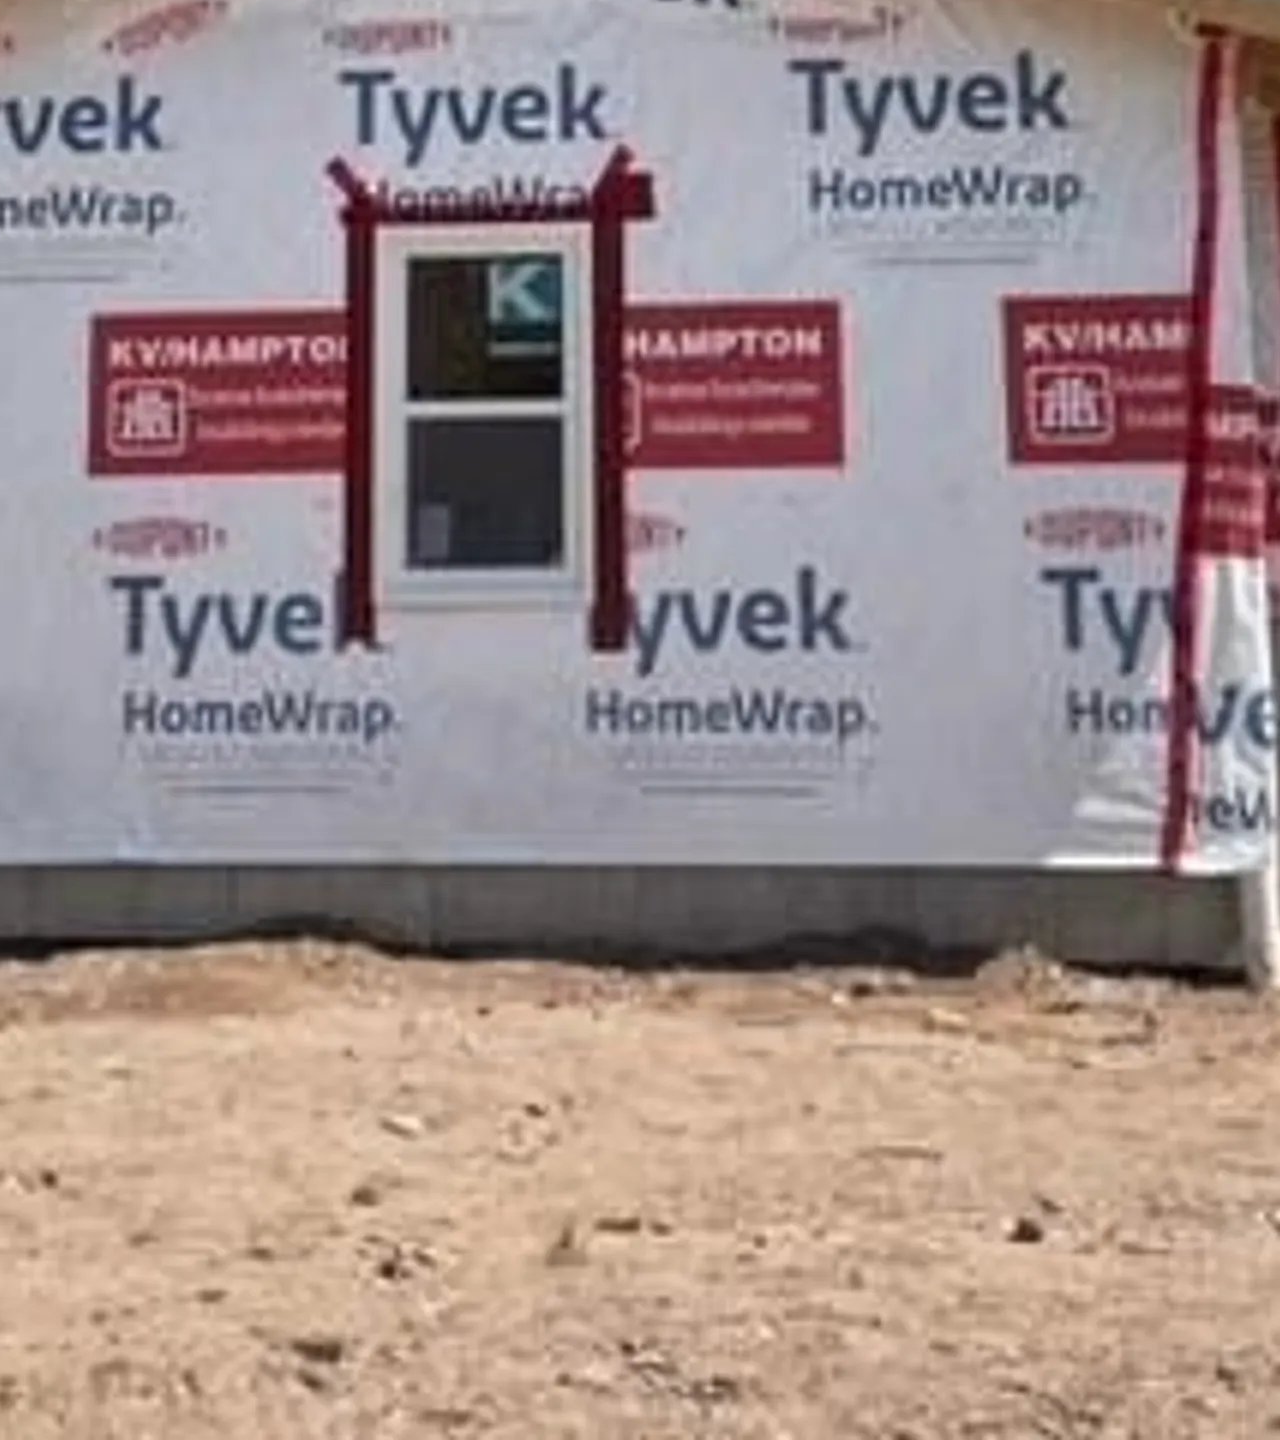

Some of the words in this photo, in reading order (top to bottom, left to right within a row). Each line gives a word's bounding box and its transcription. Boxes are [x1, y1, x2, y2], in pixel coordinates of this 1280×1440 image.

[337, 63, 608, 167] Tyvek
[788, 49, 1070, 157] Tyvek
[108, 334, 349, 368] KV/HAMPTO
